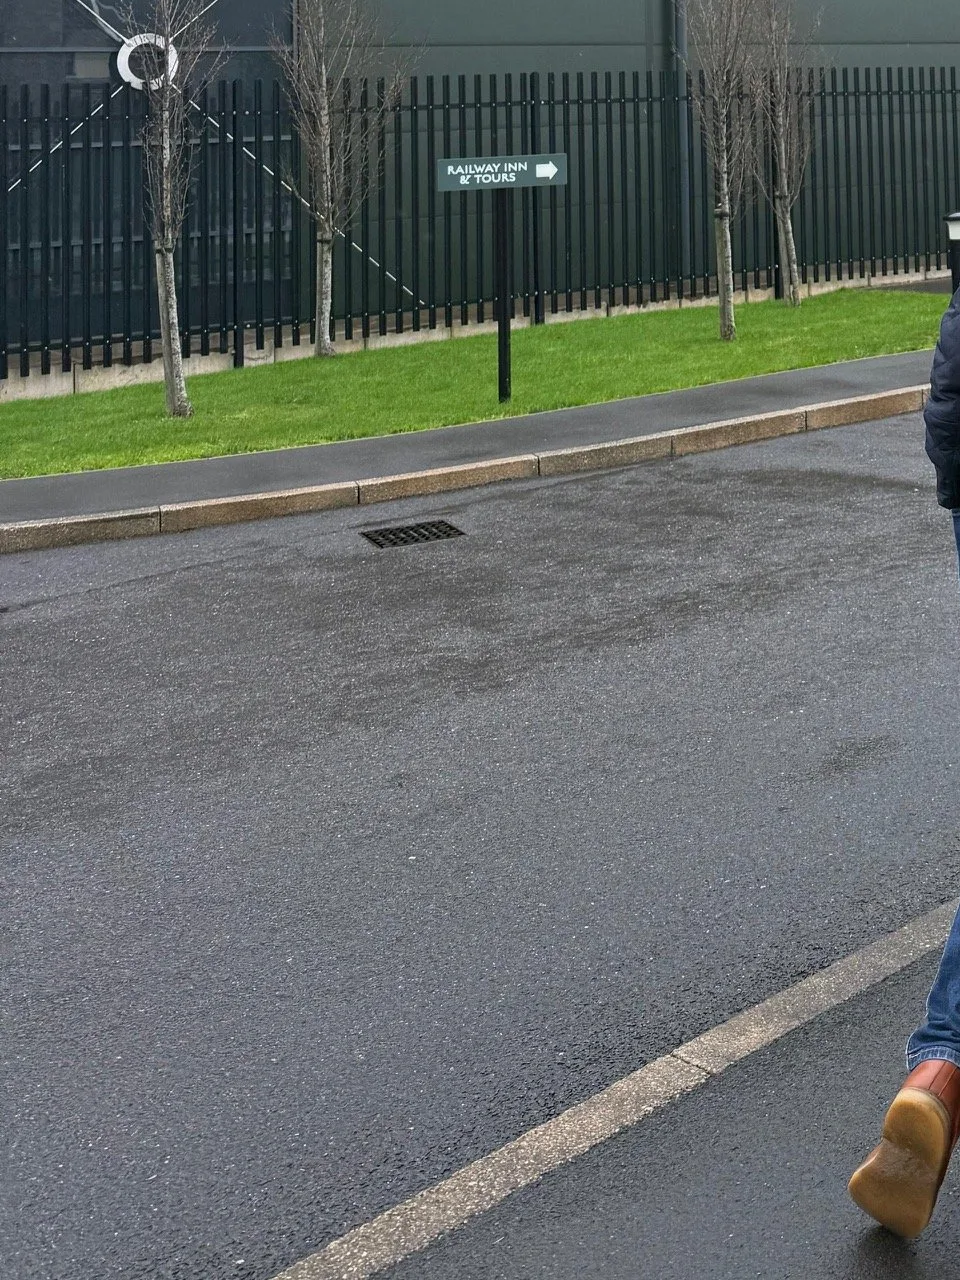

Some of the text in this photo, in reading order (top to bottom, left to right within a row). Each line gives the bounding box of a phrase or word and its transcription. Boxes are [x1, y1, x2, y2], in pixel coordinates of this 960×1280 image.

[447, 162, 528, 175] RAILWAY INN
[460, 173, 516, 184] & TOURS
